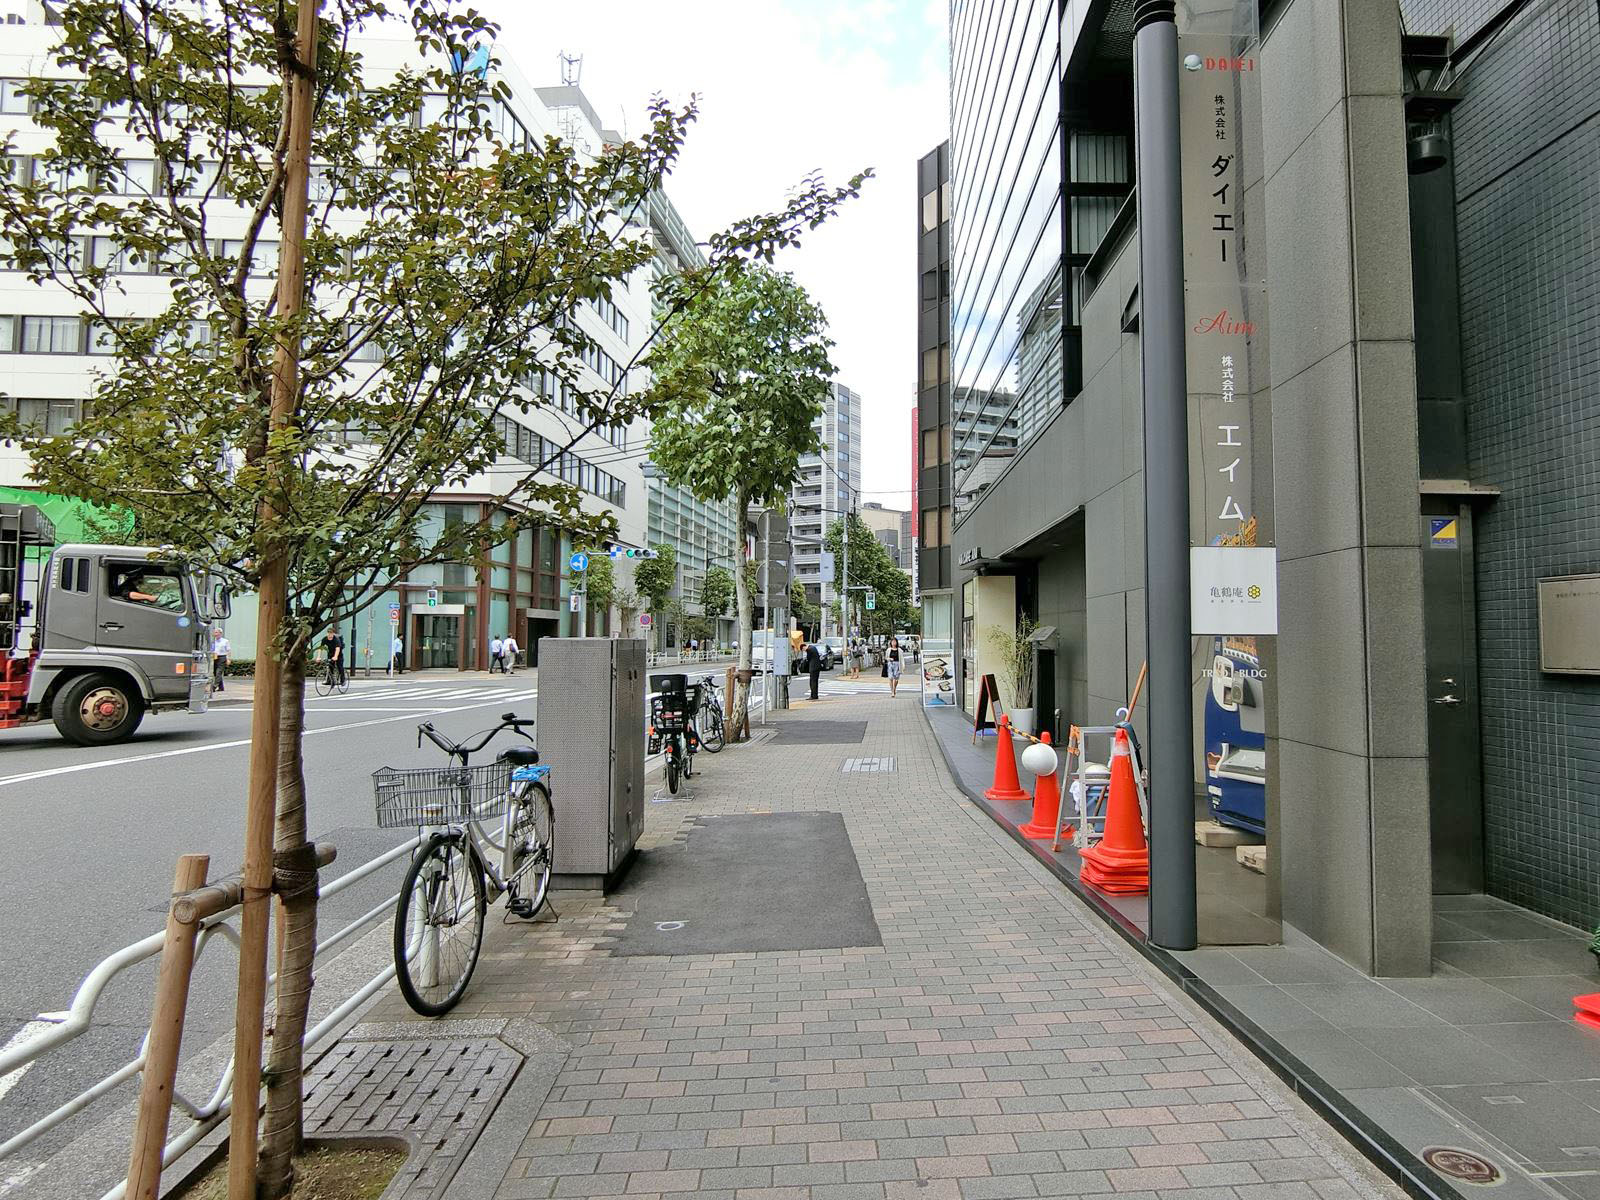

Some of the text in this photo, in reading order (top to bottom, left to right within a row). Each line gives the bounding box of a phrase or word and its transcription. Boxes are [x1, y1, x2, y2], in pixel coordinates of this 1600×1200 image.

[1205, 58, 1254, 71] DAIEI
[1211, 95, 1234, 262] 株式会社 ダイエー
[1193, 310, 1257, 336] Aim
[1217, 355, 1244, 521] 株式会社 エイム
[1239, 669, 1267, 678] BLDG
